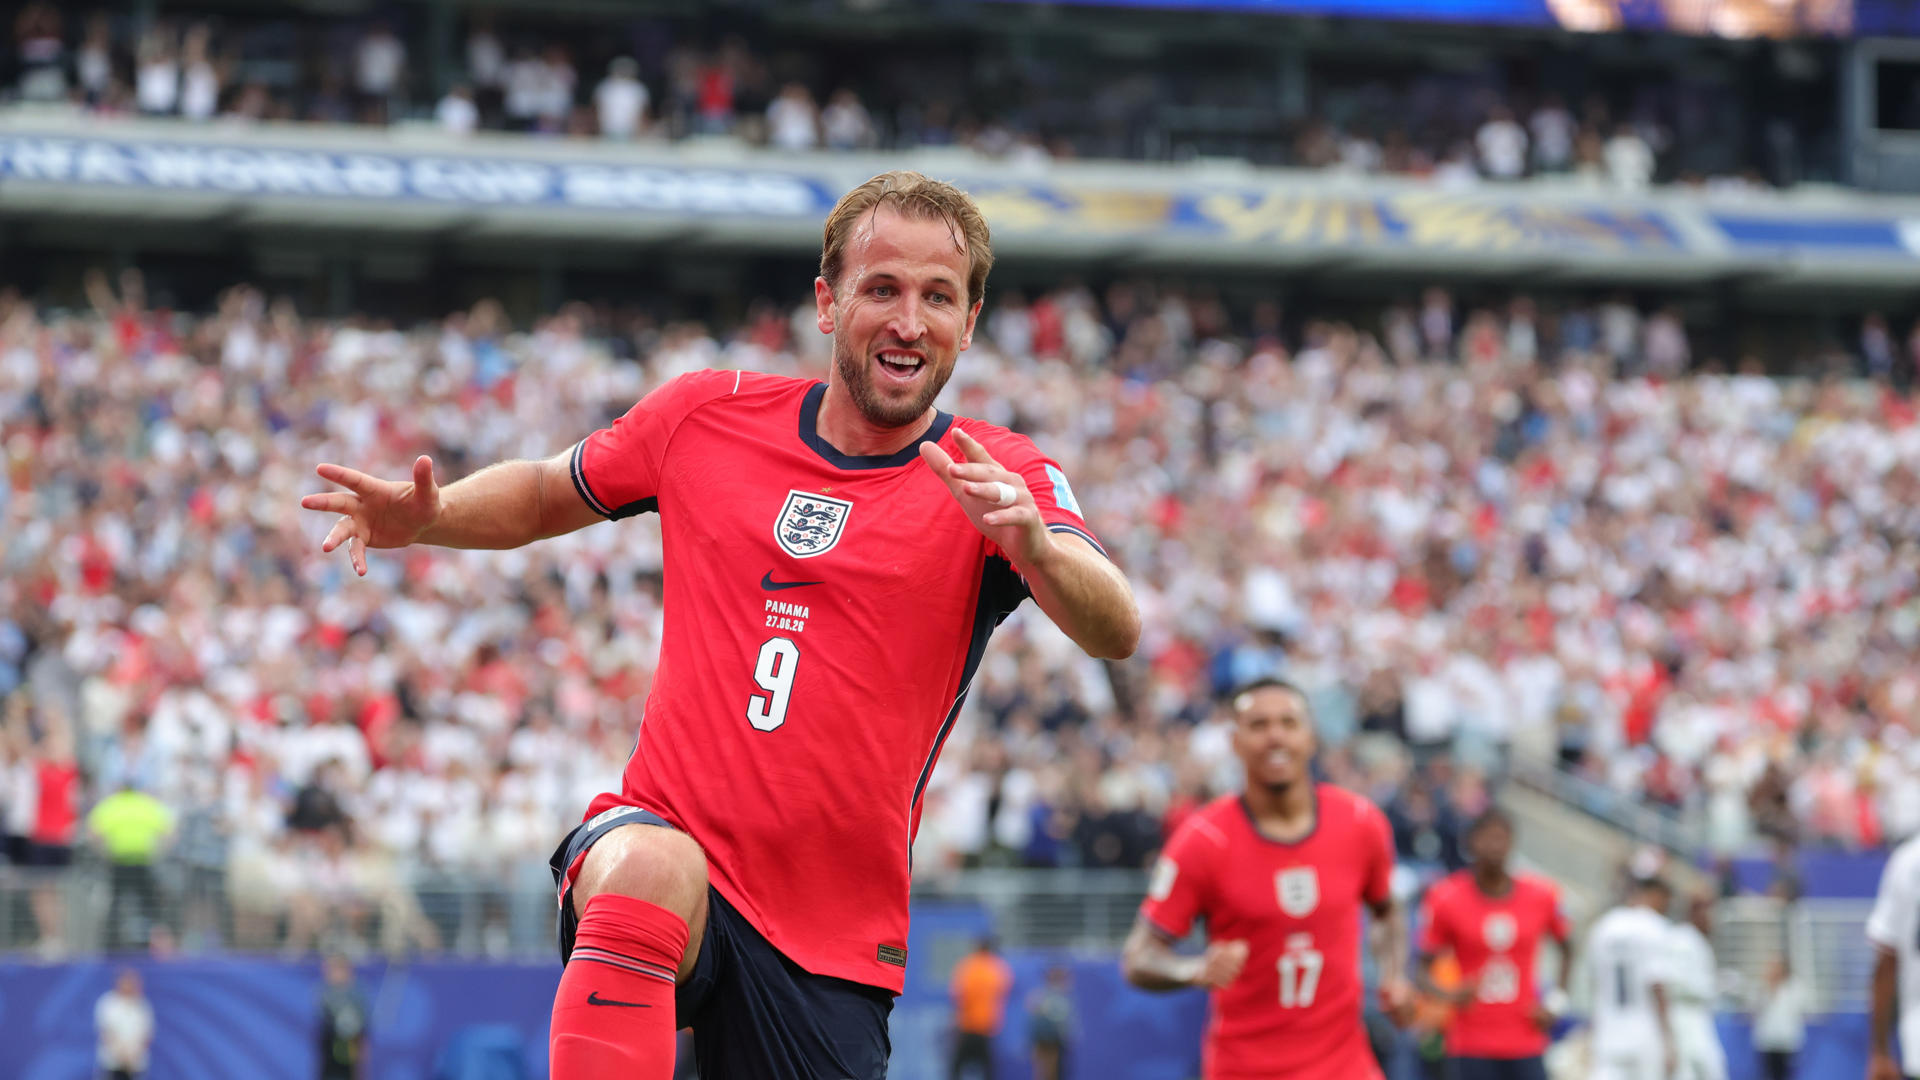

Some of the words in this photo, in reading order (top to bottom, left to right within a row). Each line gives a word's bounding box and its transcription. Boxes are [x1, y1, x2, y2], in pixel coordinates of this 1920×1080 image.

[0, 138, 134, 186] IFA
[136, 143, 401, 198] WORLD
[410, 156, 550, 205] CUP
[765, 599, 809, 619] PANAMA
[765, 615, 804, 632] 27.06.26
[746, 636, 800, 733] 9
[1277, 949, 1323, 1008] 17
